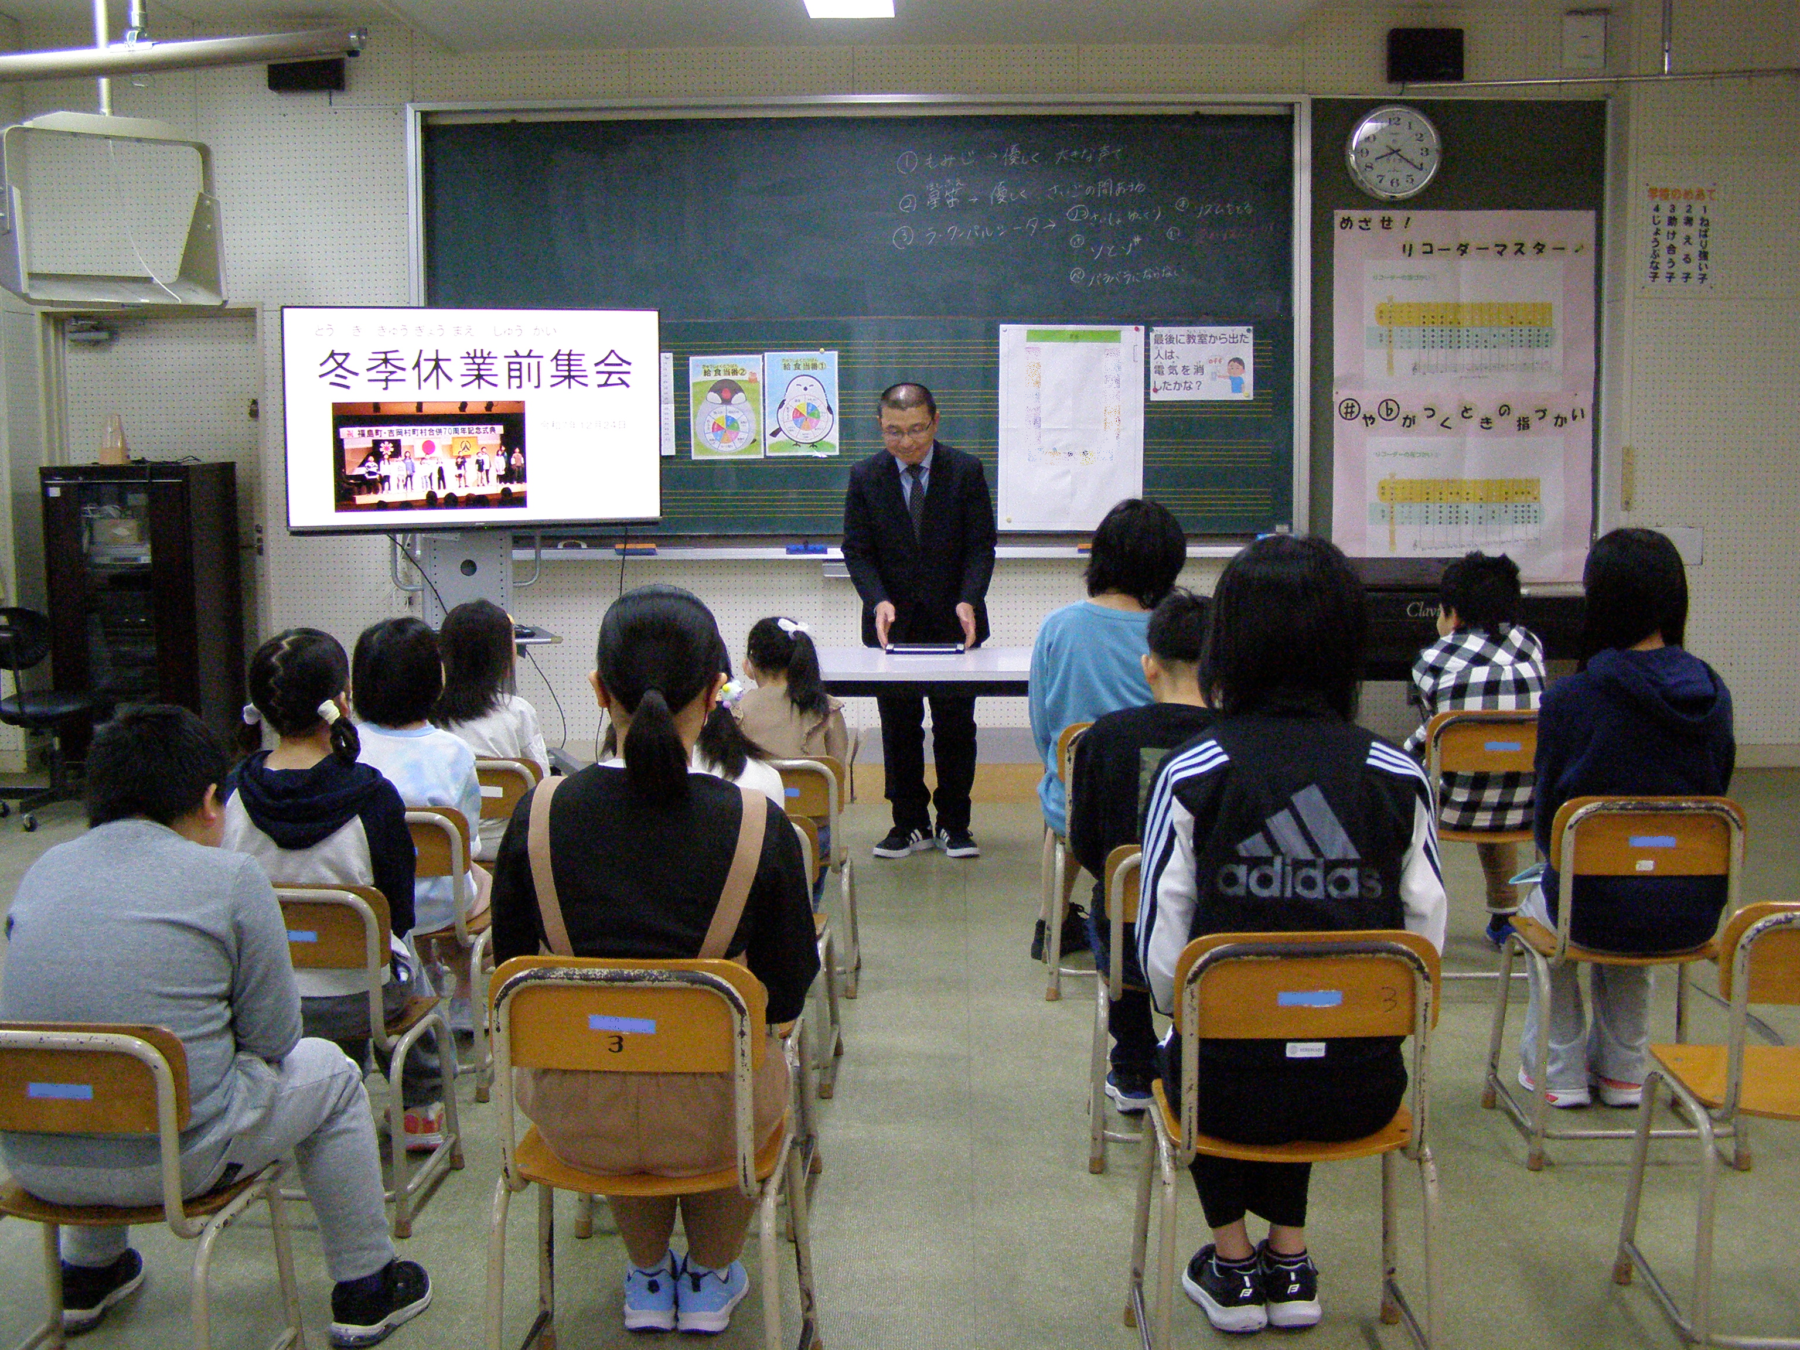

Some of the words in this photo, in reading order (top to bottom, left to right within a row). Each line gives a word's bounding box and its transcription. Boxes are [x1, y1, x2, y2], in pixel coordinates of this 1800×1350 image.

[1389, 117, 1401, 126] 12
[1407, 122, 1412, 130] 1
[1415, 133, 1424, 142] 2
[1360, 148, 1370, 158] 9
[1420, 147, 1429, 157] 3
[1364, 162, 1374, 172] 8
[1376, 175, 1385, 183] 7
[1390, 178, 1400, 188] 6
[1406, 174, 1414, 184] 5
[314, 323, 335, 337] とう
[377, 324, 409, 338] きゅう
[452, 324, 475, 338] まえ
[493, 324, 524, 338] しゅう
[533, 325, 557, 337] かい
[1154, 333, 1250, 345] 最後に教室から出た
[1154, 350, 1180, 360] 人は、
[318, 348, 632, 390] 冬季休業前集会
[1154, 364, 1204, 376] 電気を消
[1217, 855, 1382, 899] adidas
[1381, 986, 1397, 1013] 3
[608, 1035, 624, 1053] 3
